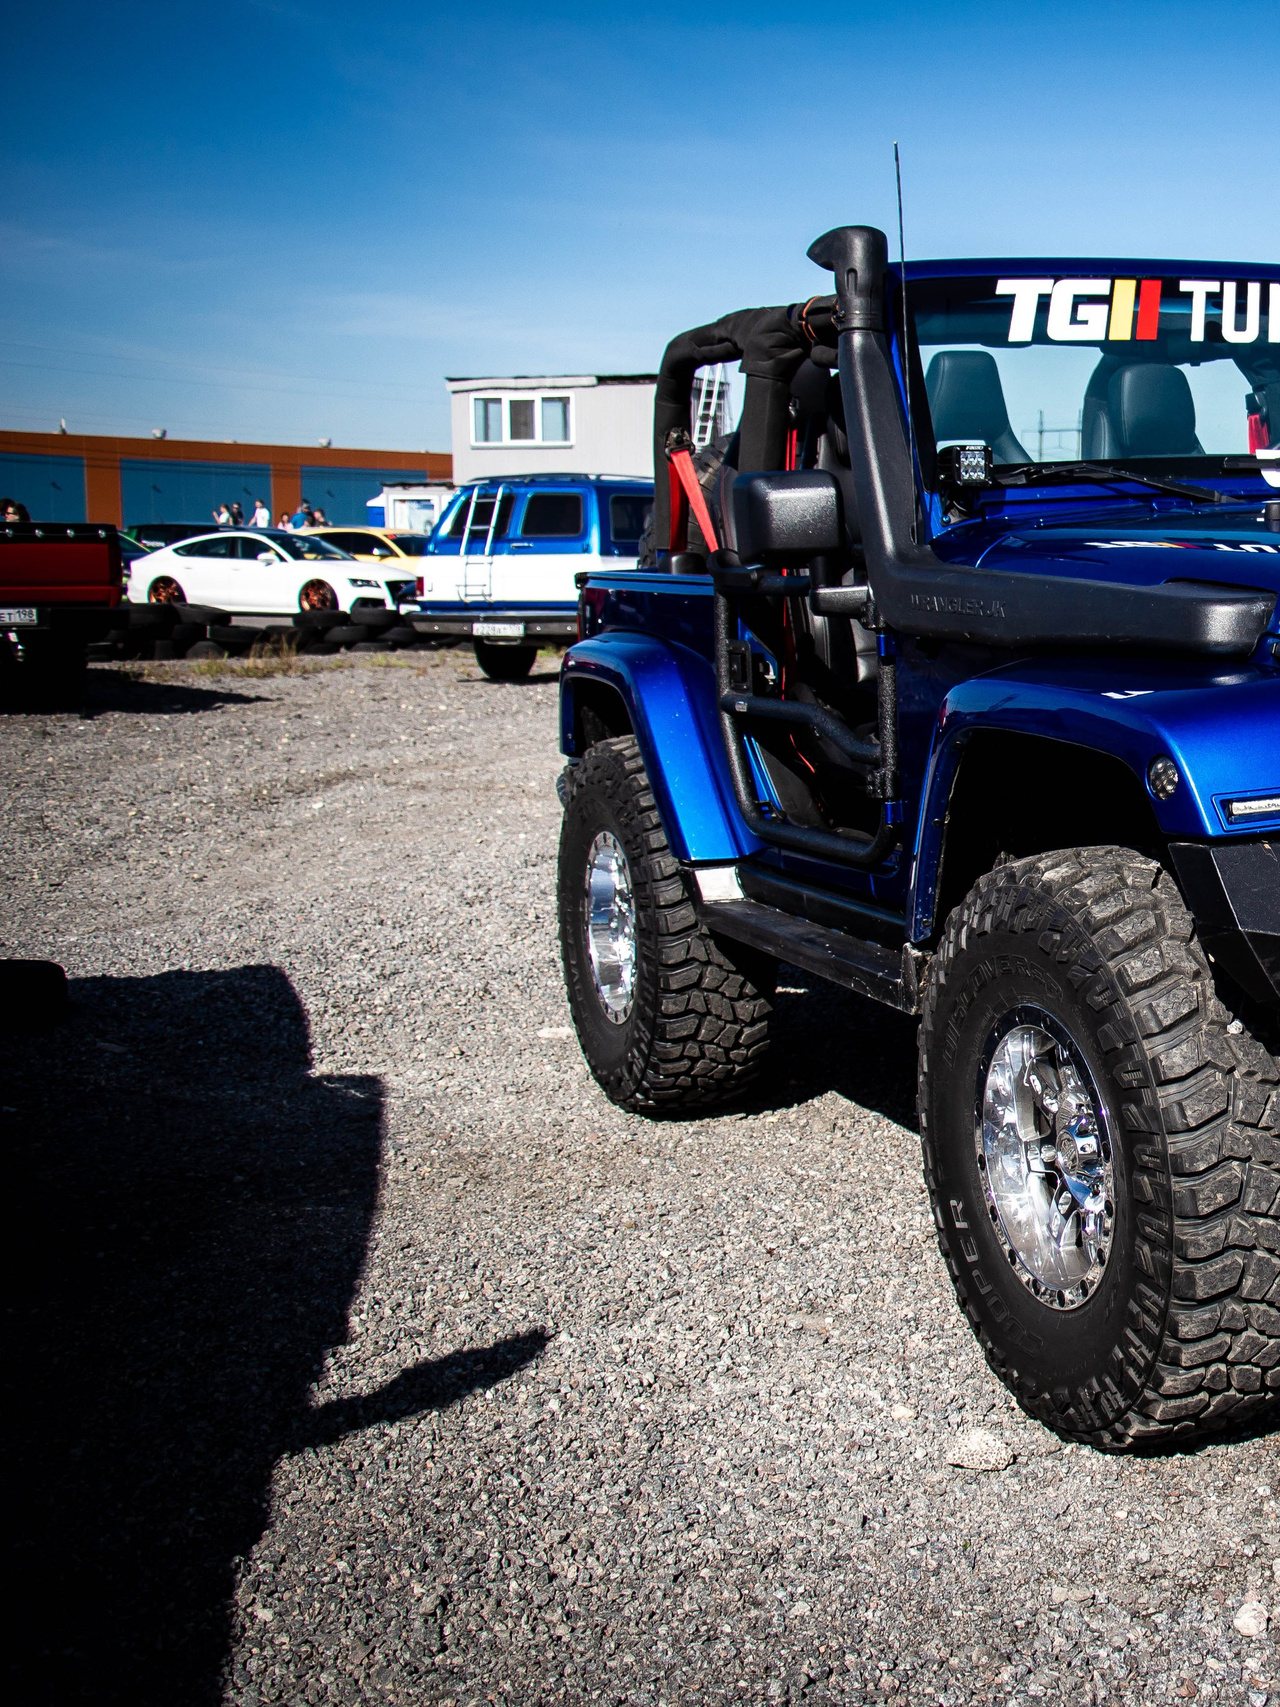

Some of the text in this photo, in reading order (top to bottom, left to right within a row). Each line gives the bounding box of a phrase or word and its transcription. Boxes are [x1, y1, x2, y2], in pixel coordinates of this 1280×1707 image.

[15, 609, 35, 619] 198
[910, 593, 1007, 618] WRANGLER JK
[942, 953, 1064, 1070] DISCOVERER
[949, 1197, 1044, 1358] COOPER
